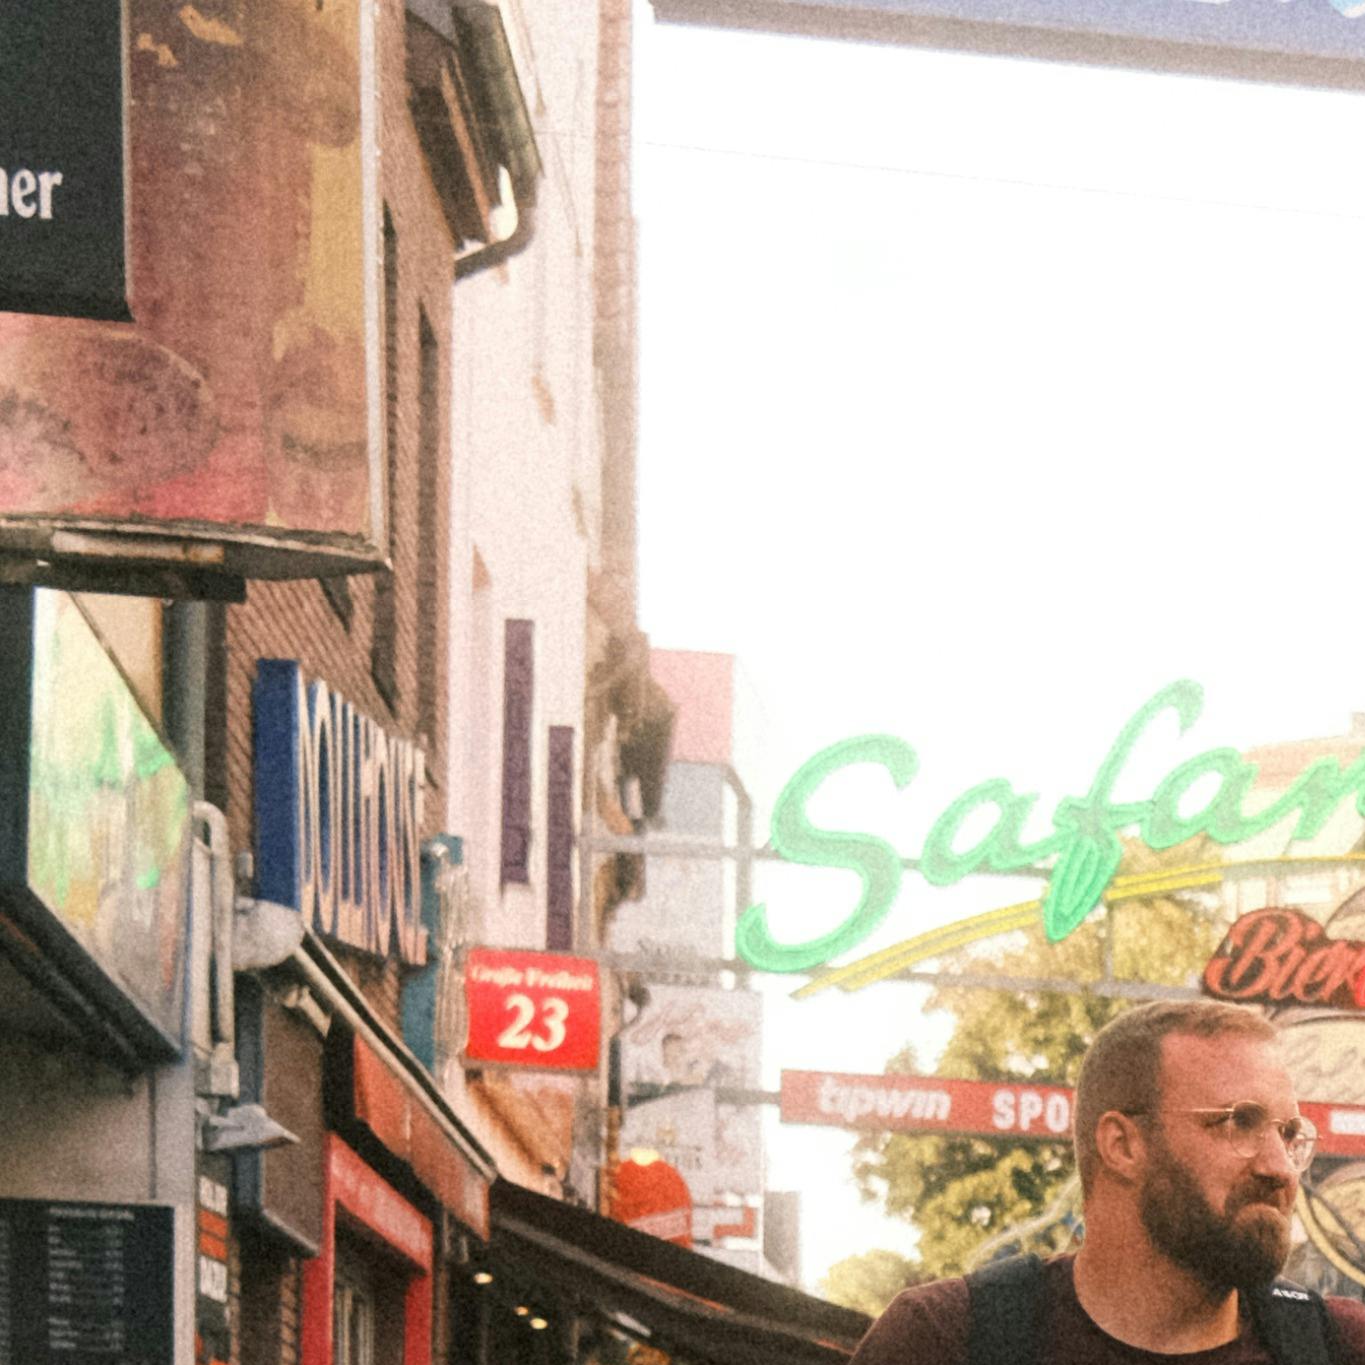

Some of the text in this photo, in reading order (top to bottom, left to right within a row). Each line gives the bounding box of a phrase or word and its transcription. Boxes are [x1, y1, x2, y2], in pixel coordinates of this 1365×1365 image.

[497, 993, 570, 1052] 23
[818, 1075, 1070, 1134] tipwin SPO
